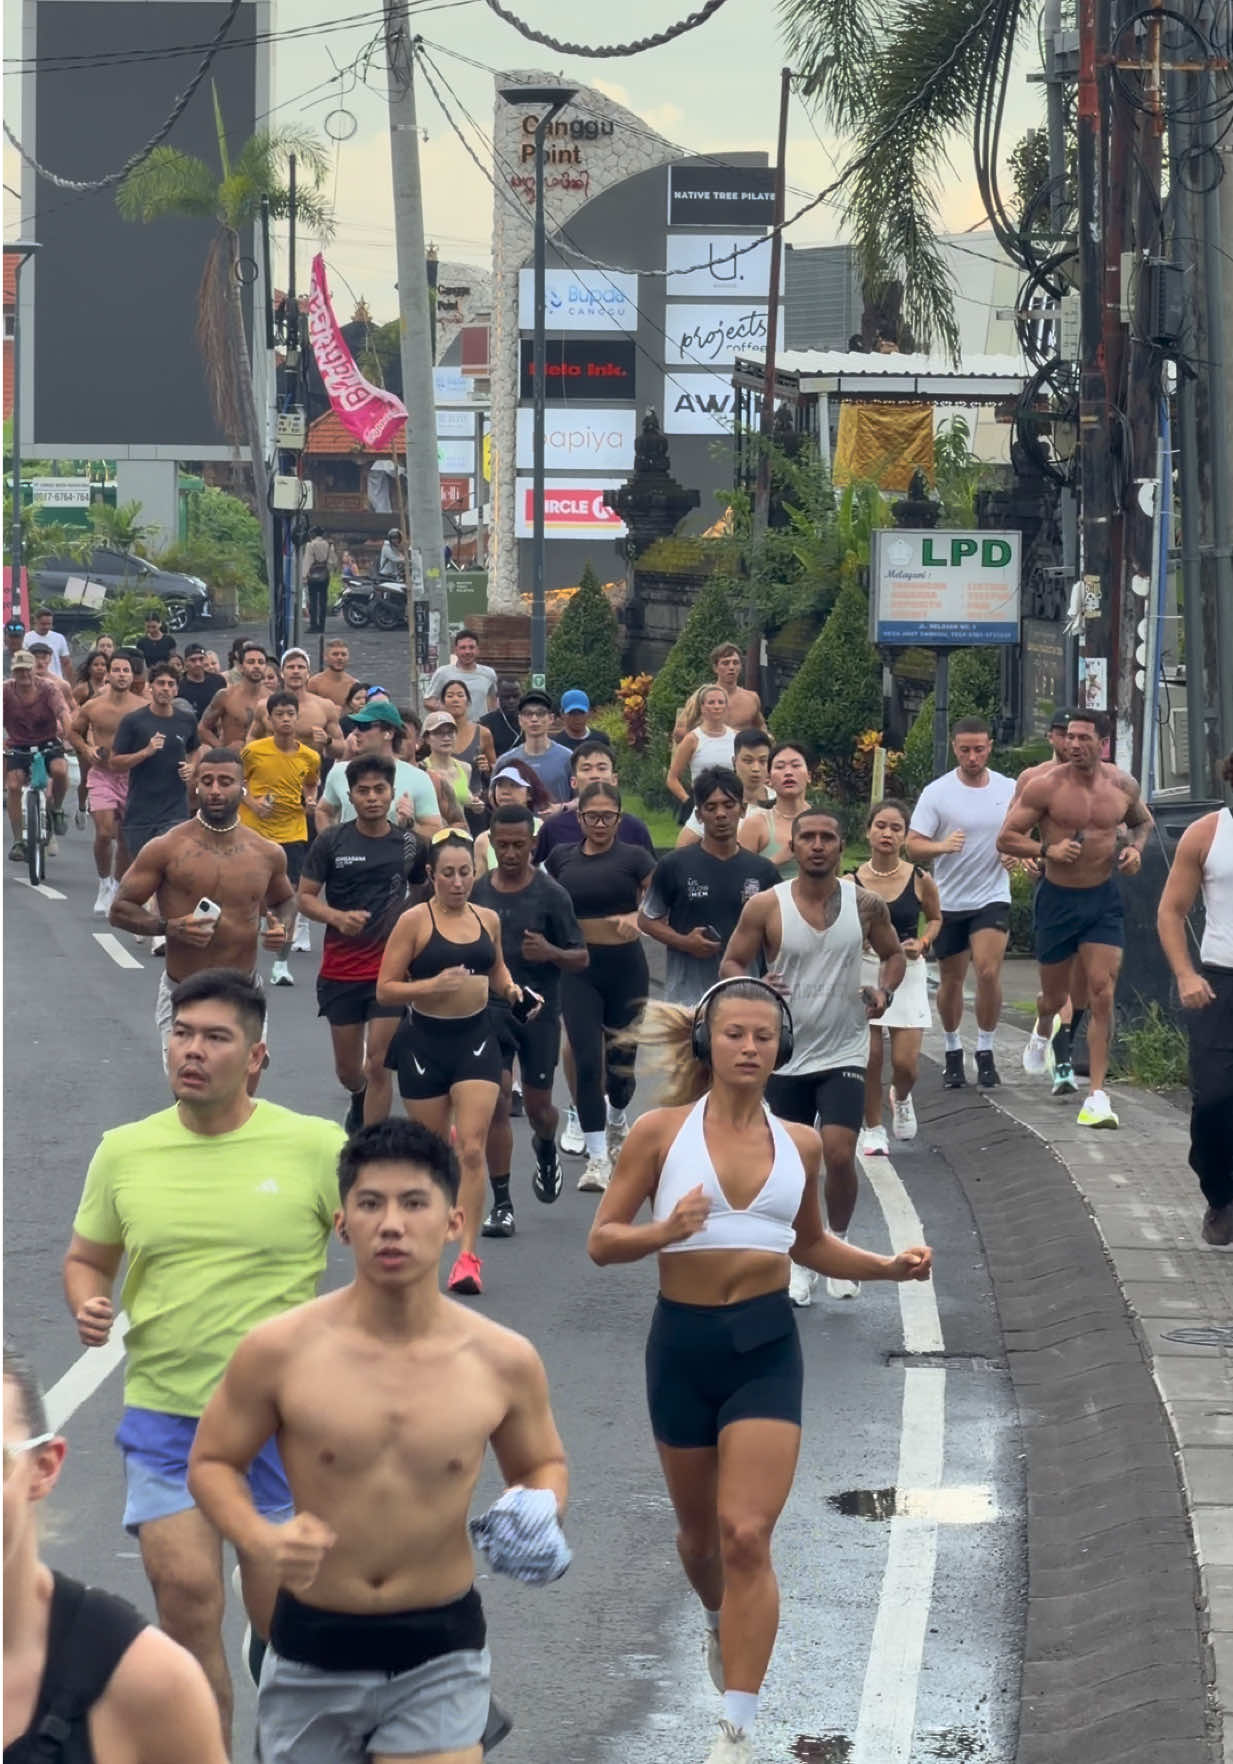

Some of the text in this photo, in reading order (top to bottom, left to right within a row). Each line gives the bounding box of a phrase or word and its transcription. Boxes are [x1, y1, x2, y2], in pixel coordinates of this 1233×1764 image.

[522, 114, 615, 140] Canggu
[674, 191, 776, 201] NATIVE TREE PILATE
[568, 307, 625, 316] CANGGU
[680, 310, 769, 359] projects
[587, 362, 628, 376] Ink.
[532, 425, 623, 453] apiya
[543, 500, 589, 514] IRCLE
[921, 538, 1012, 568] LPD
